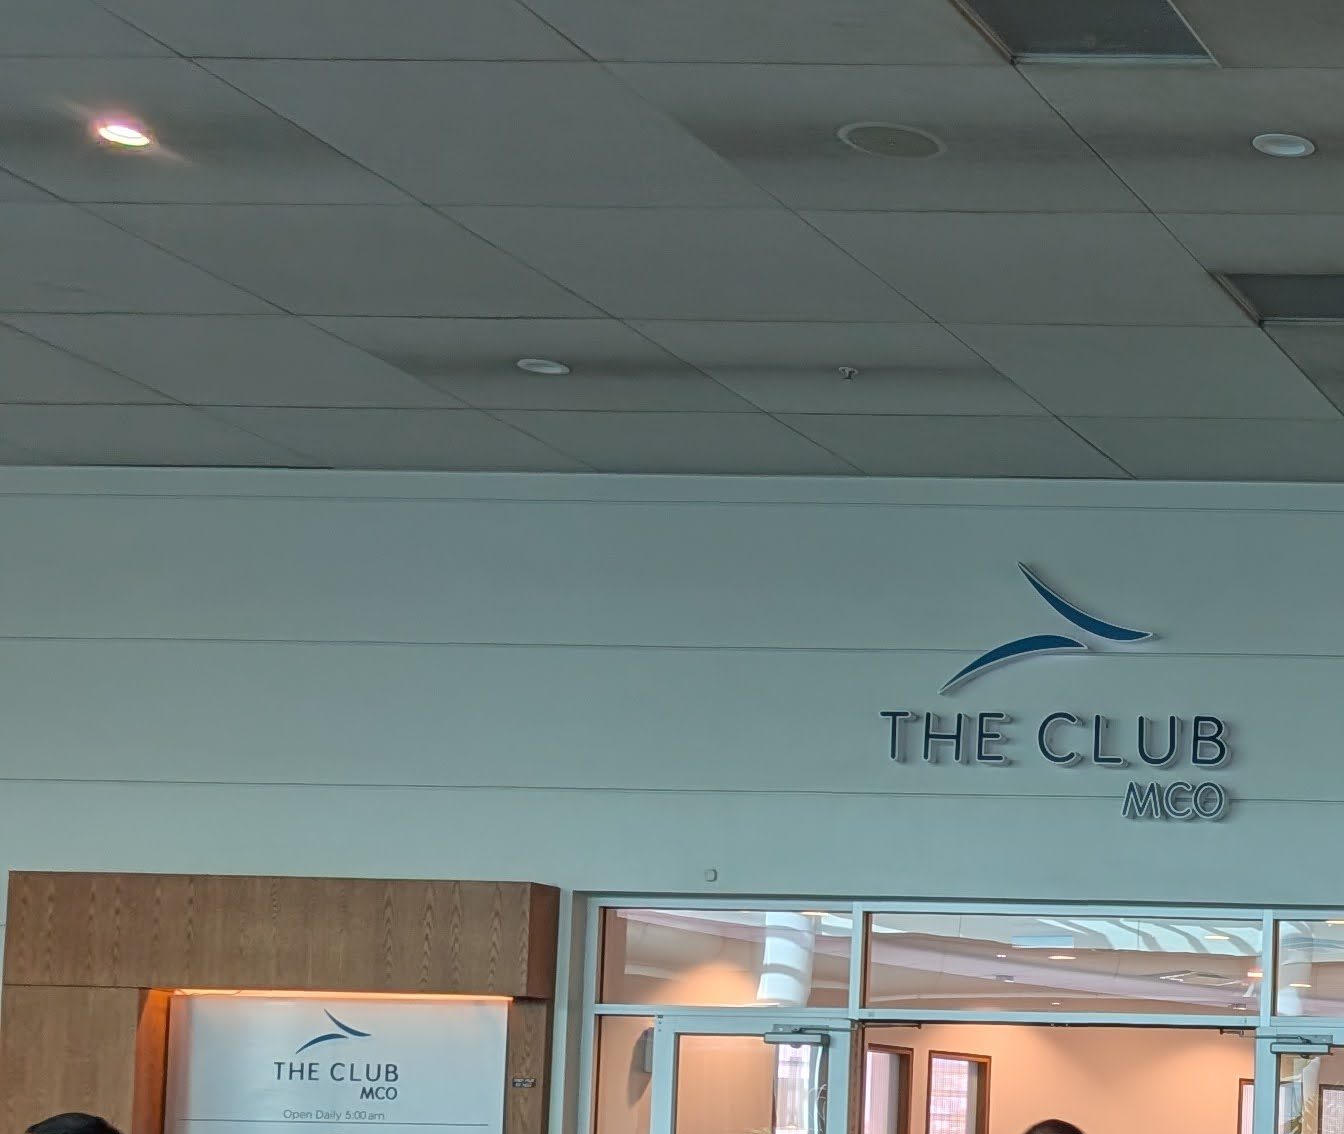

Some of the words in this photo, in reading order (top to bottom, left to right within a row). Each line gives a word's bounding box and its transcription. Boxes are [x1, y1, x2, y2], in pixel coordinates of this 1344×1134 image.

[880, 710, 1008, 763] THE
[1038, 711, 1229, 767] CLUB
[1121, 780, 1227, 820] MCO
[274, 1061, 320, 1080] THE
[330, 1062, 399, 1082] CLUB
[360, 1086, 398, 1100] MCO
[283, 1109, 312, 1120] Open
[315, 1110, 341, 1121] Daily
